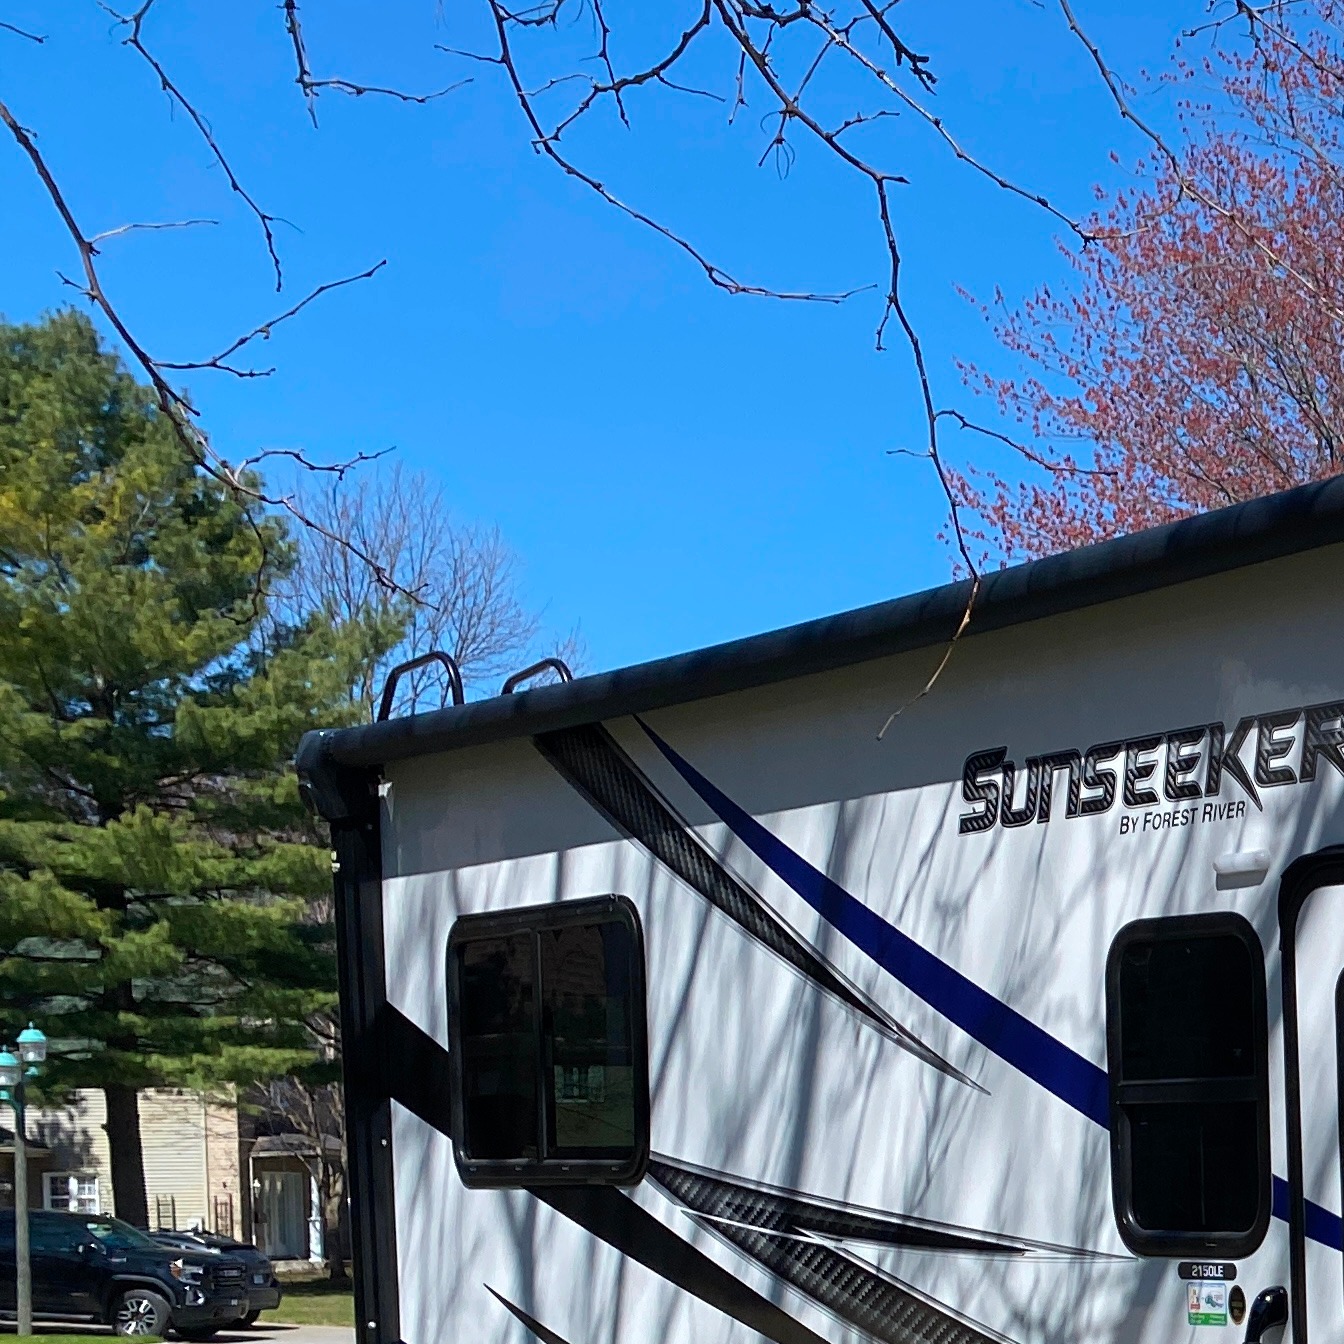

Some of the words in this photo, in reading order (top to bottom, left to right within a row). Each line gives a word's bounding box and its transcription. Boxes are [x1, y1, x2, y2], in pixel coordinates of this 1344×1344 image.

[1119, 815, 1140, 835] BY
[1142, 808, 1199, 832] FOREST
[1201, 801, 1246, 824] RIVER
[1191, 1264, 1224, 1278] 2150LE
